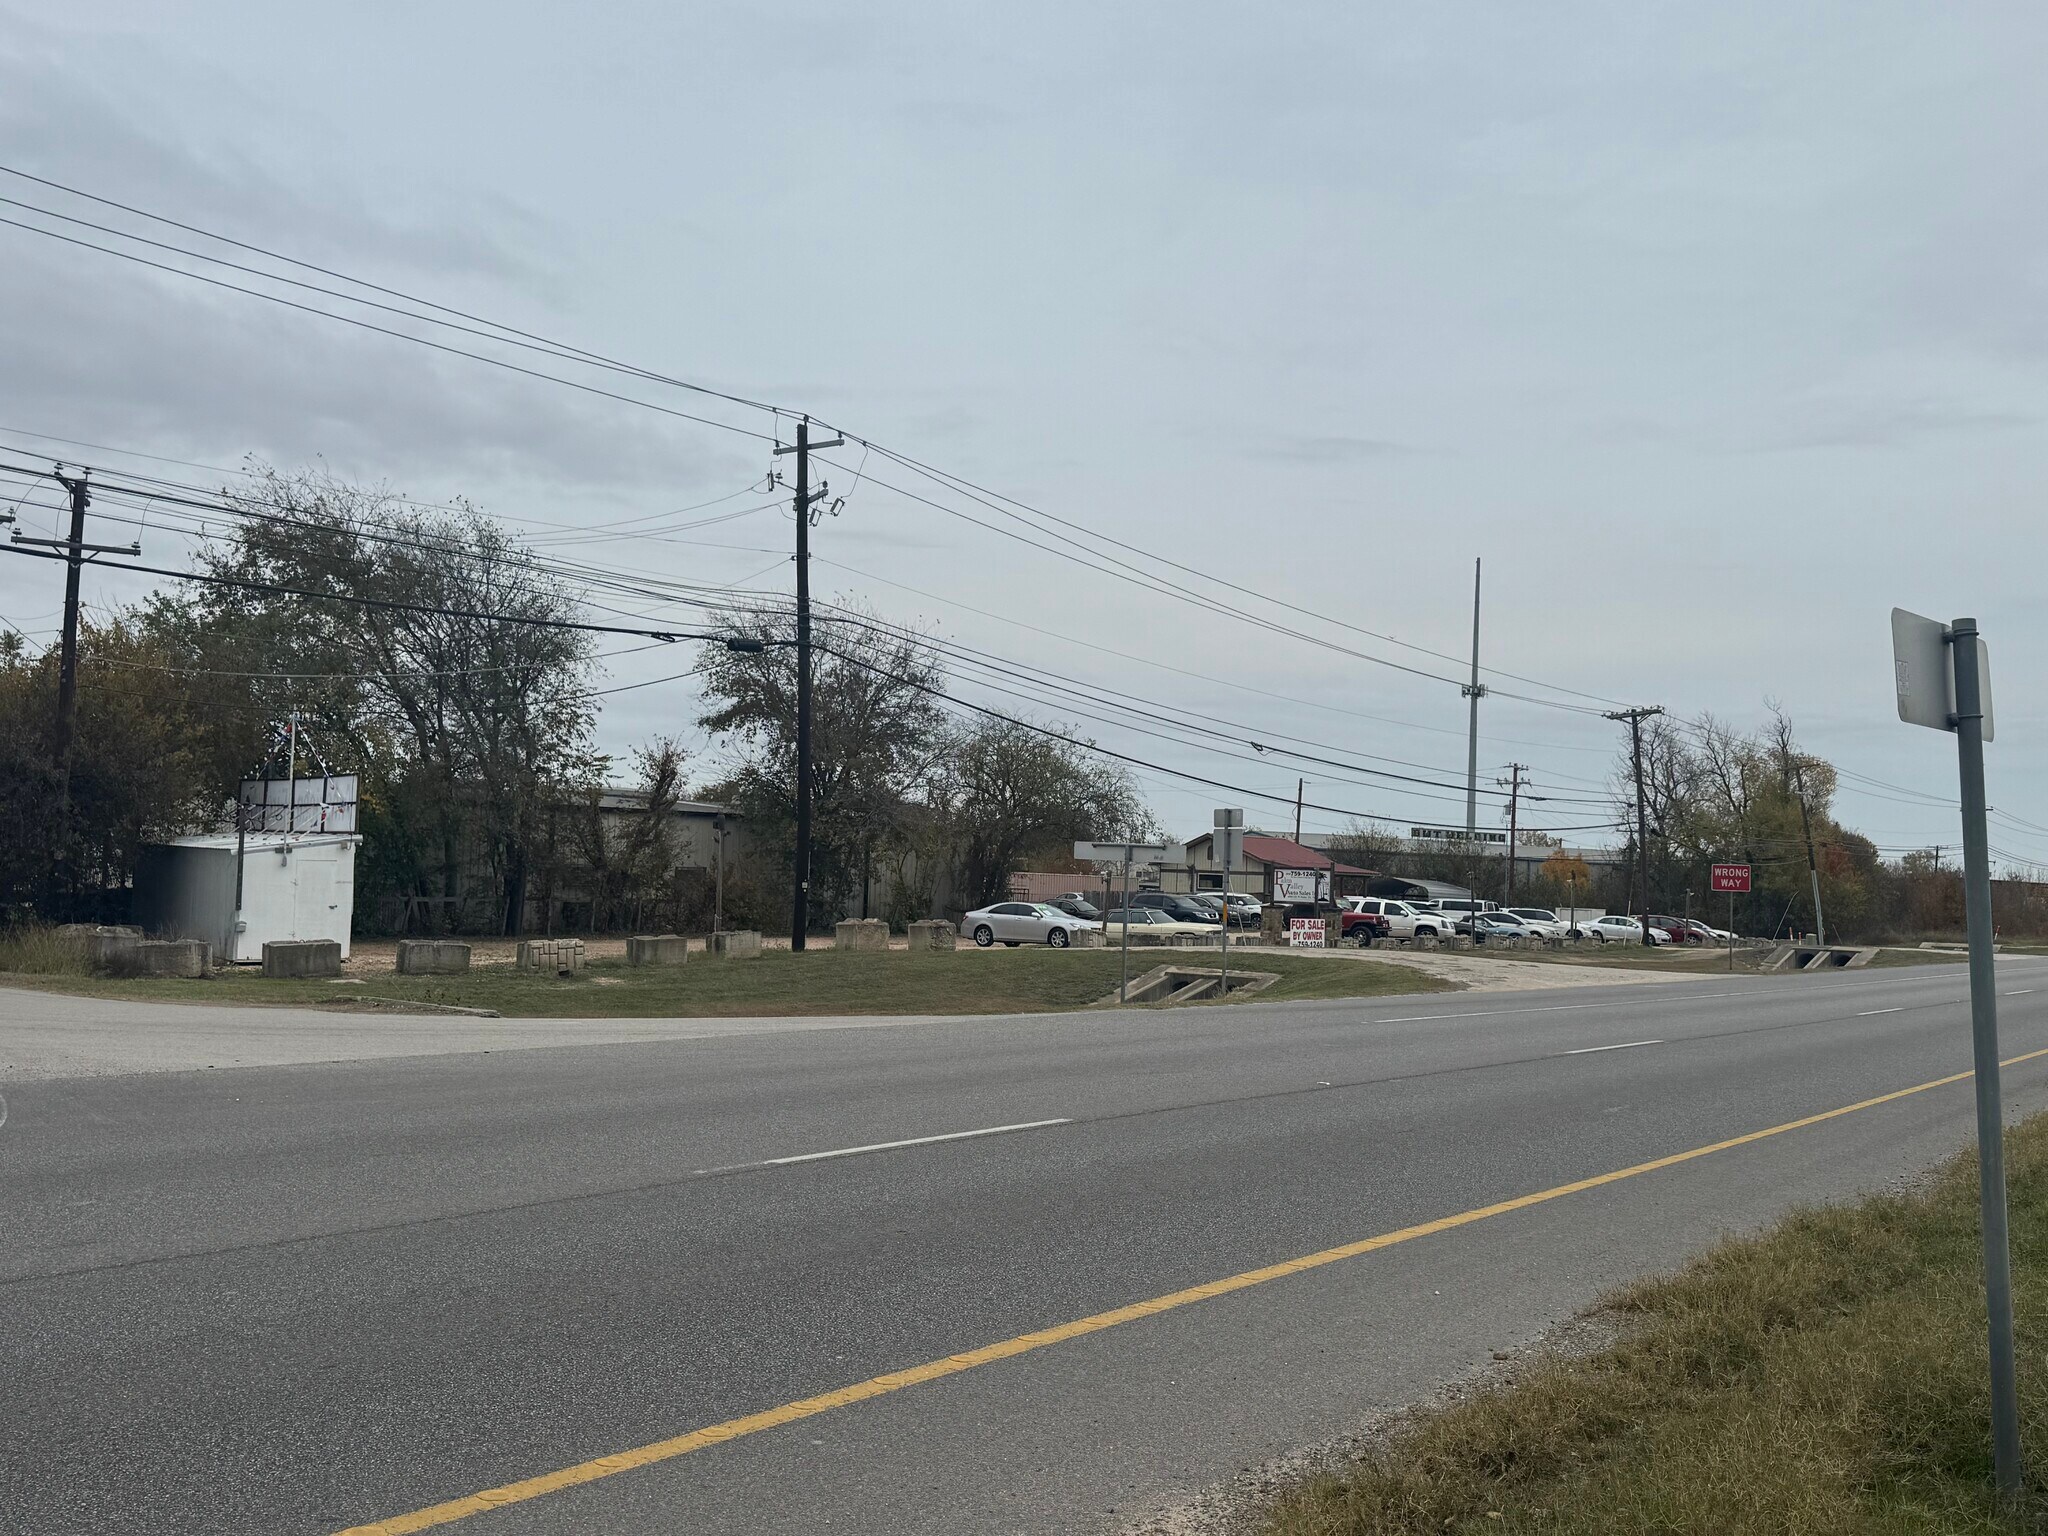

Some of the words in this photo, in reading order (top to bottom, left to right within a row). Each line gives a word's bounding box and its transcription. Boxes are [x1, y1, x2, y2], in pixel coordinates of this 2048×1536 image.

[1714, 868, 1749, 877] WRONG
[1720, 878, 1742, 887] WAY
[1279, 883, 1304, 898] Valley
[1291, 920, 1306, 930] FOR
[1307, 920, 1325, 930] SALE
[1293, 931, 1301, 940] BY
[1302, 931, 1323, 940] OWNER
